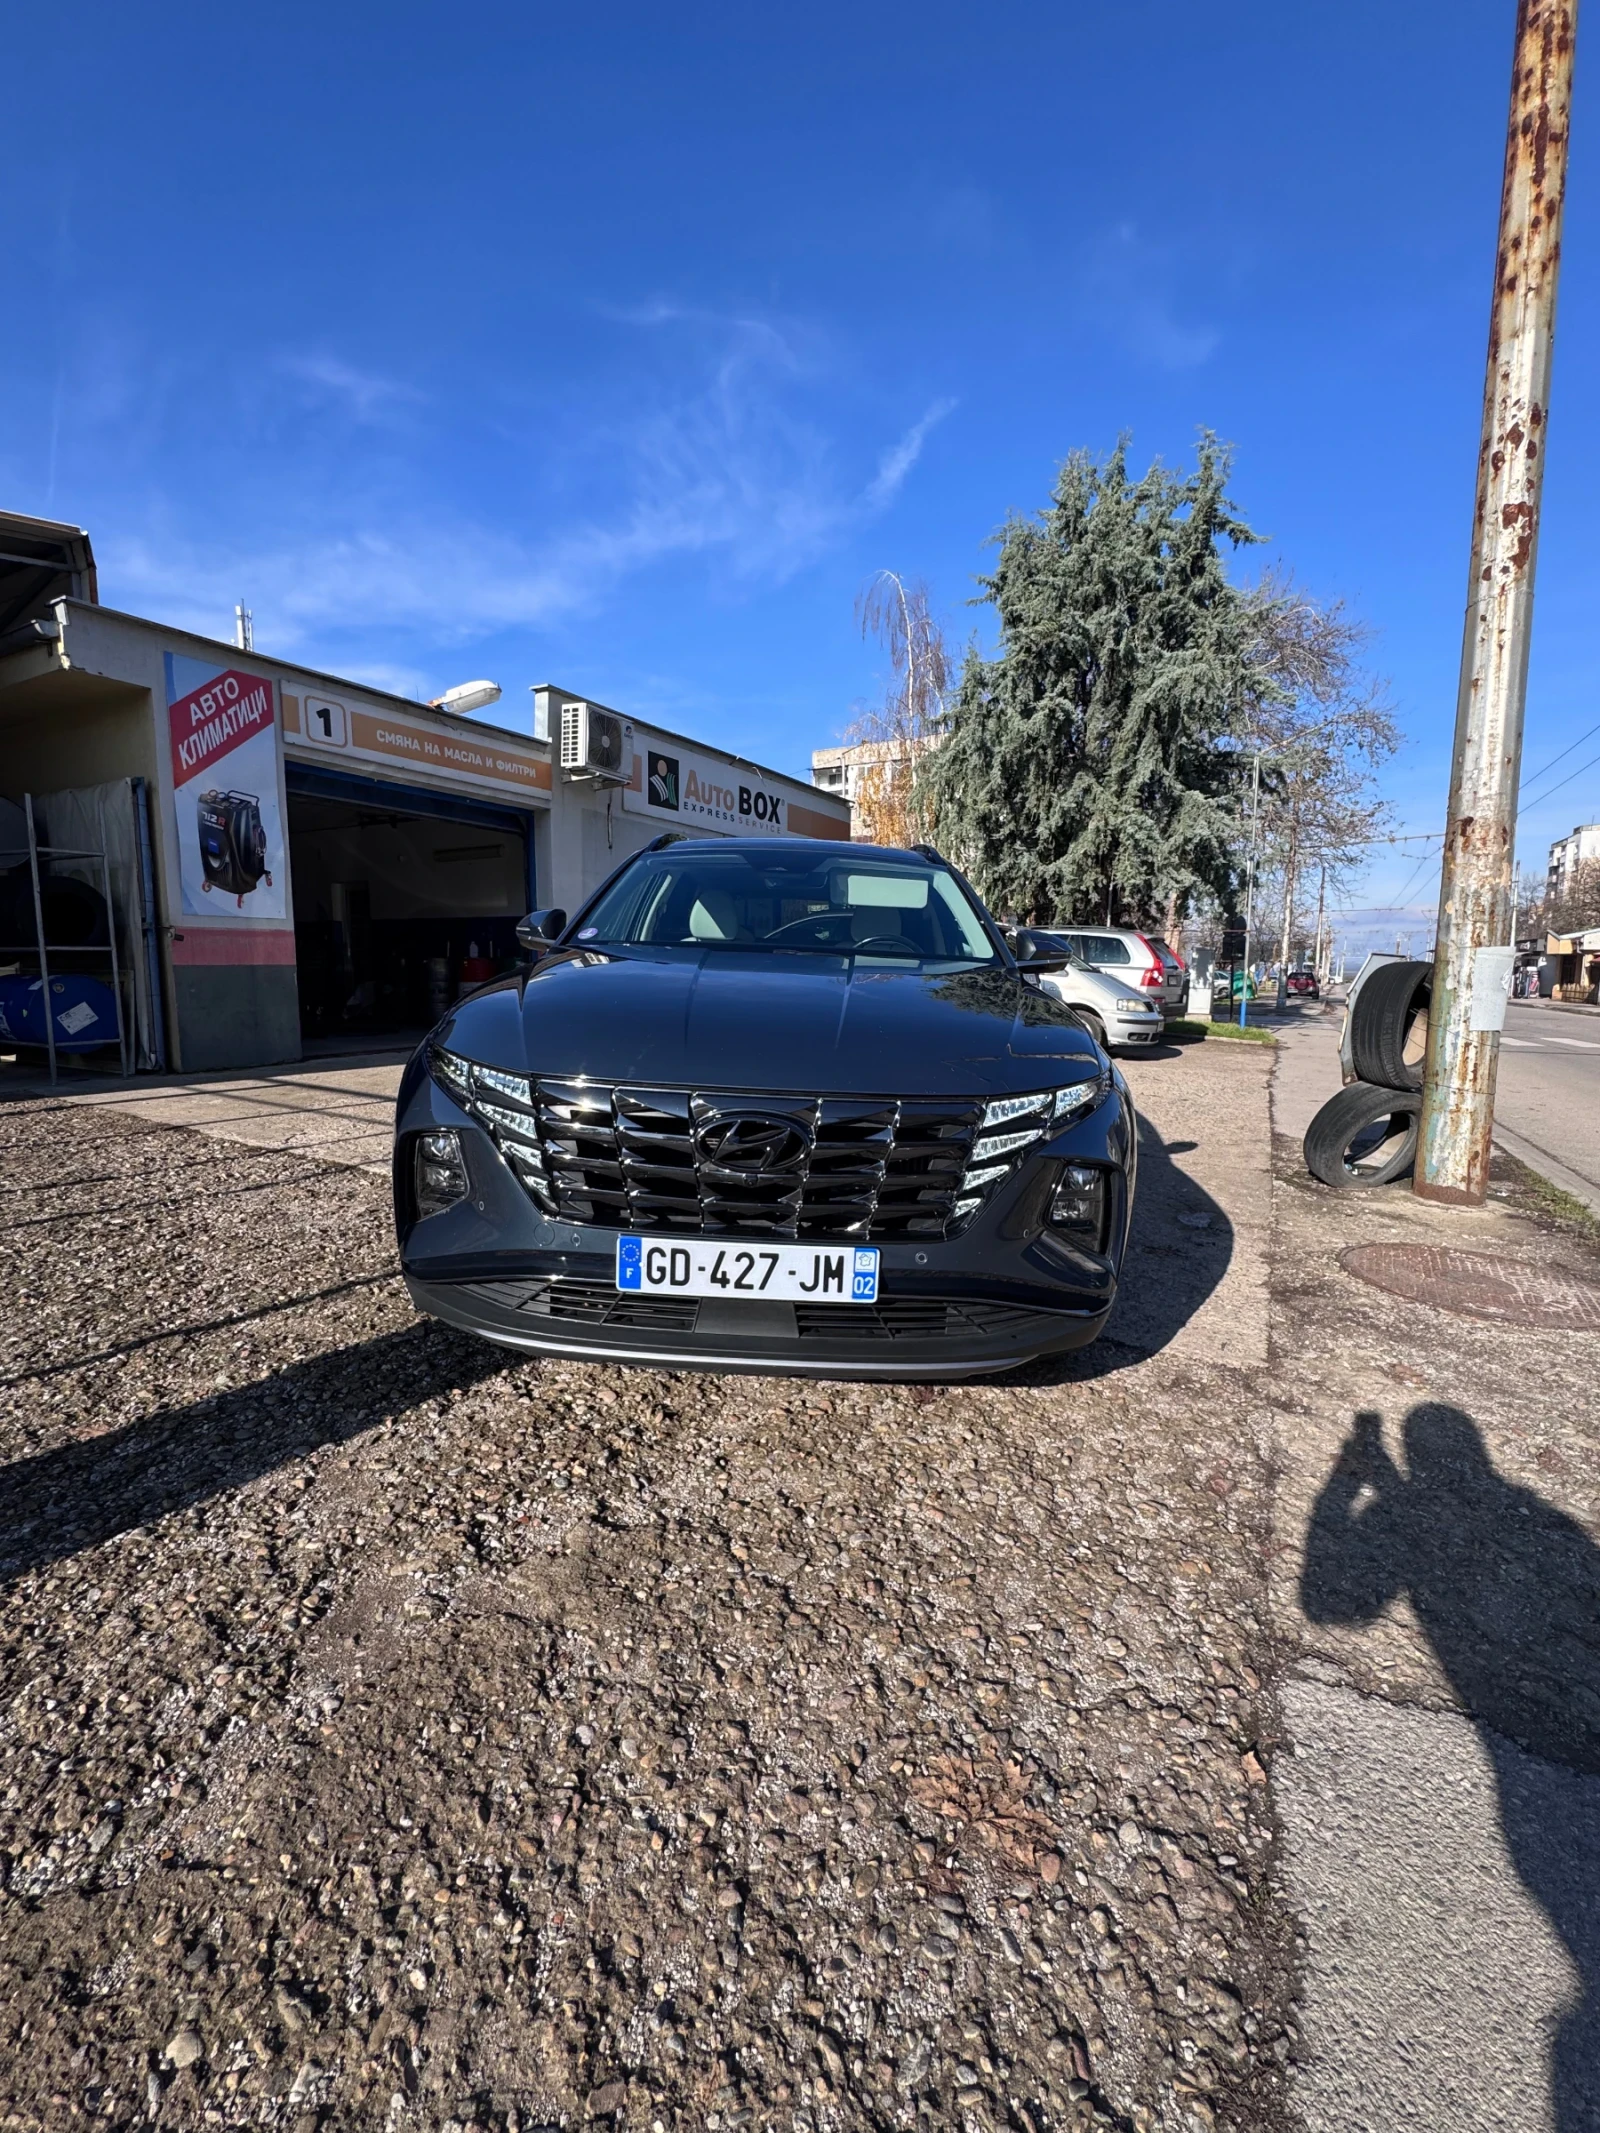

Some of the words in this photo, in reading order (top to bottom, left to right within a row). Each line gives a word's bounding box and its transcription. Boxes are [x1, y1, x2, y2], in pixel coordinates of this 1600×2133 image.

[189, 677, 239, 727] АВТО
[315, 707, 332, 738] 1
[178, 686, 268, 770] КЛИМАТИЦИ
[376, 729, 421, 751] СМЯНА
[424, 741, 441, 757] НА
[444, 746, 482, 765] МАСЛА
[485, 757, 493, 768] И
[496, 759, 536, 779] ФИЛТРИ
[683, 801, 735, 822] EXPRESS
[738, 817, 781, 834] SERVICE
[684, 769, 735, 811] AUTO
[738, 785, 781, 824] BOX
[626, 1268, 634, 1278] F
[646, 1246, 844, 1294] GD-427-JM
[853, 1276, 874, 1295] 02
